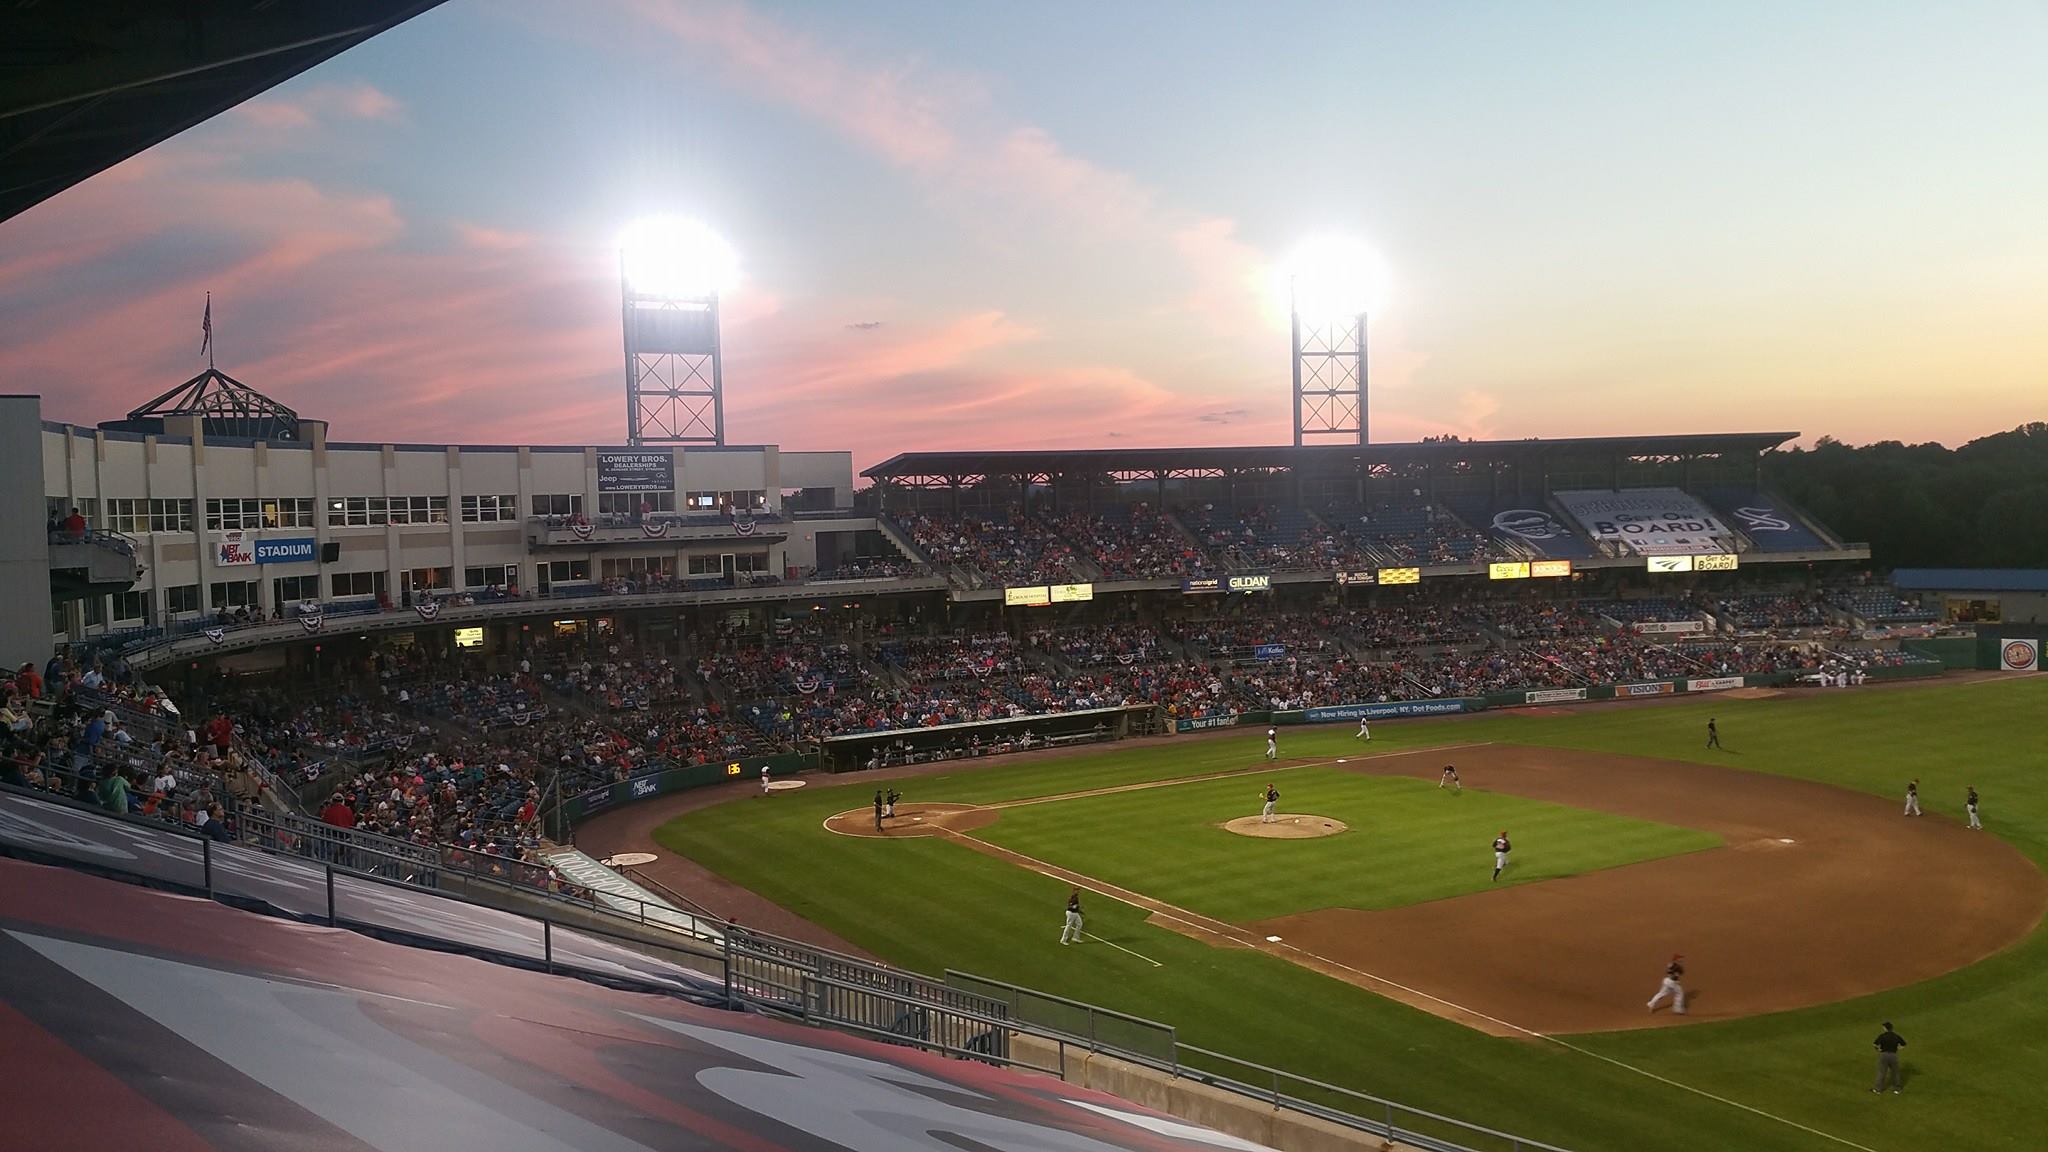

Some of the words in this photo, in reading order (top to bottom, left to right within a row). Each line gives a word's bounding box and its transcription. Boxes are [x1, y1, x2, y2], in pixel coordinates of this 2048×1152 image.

[602, 455, 639, 463] LOWERY
[641, 455, 668, 463] BROS.
[599, 475, 618, 483] Jeep
[1595, 518, 1717, 535] BOARD!
[258, 544, 312, 557] STADIUM
[227, 552, 252, 563] BANK
[1698, 559, 1734, 570] BOARD!
[1229, 576, 1269, 588] GILDAN
[1627, 683, 1665, 693] VISIONS
[1337, 710, 1358, 718] Hiring
[1191, 719, 1207, 729] Your
[1207, 718, 1217, 727] #1
[552, 853, 609, 879] CROUSE
